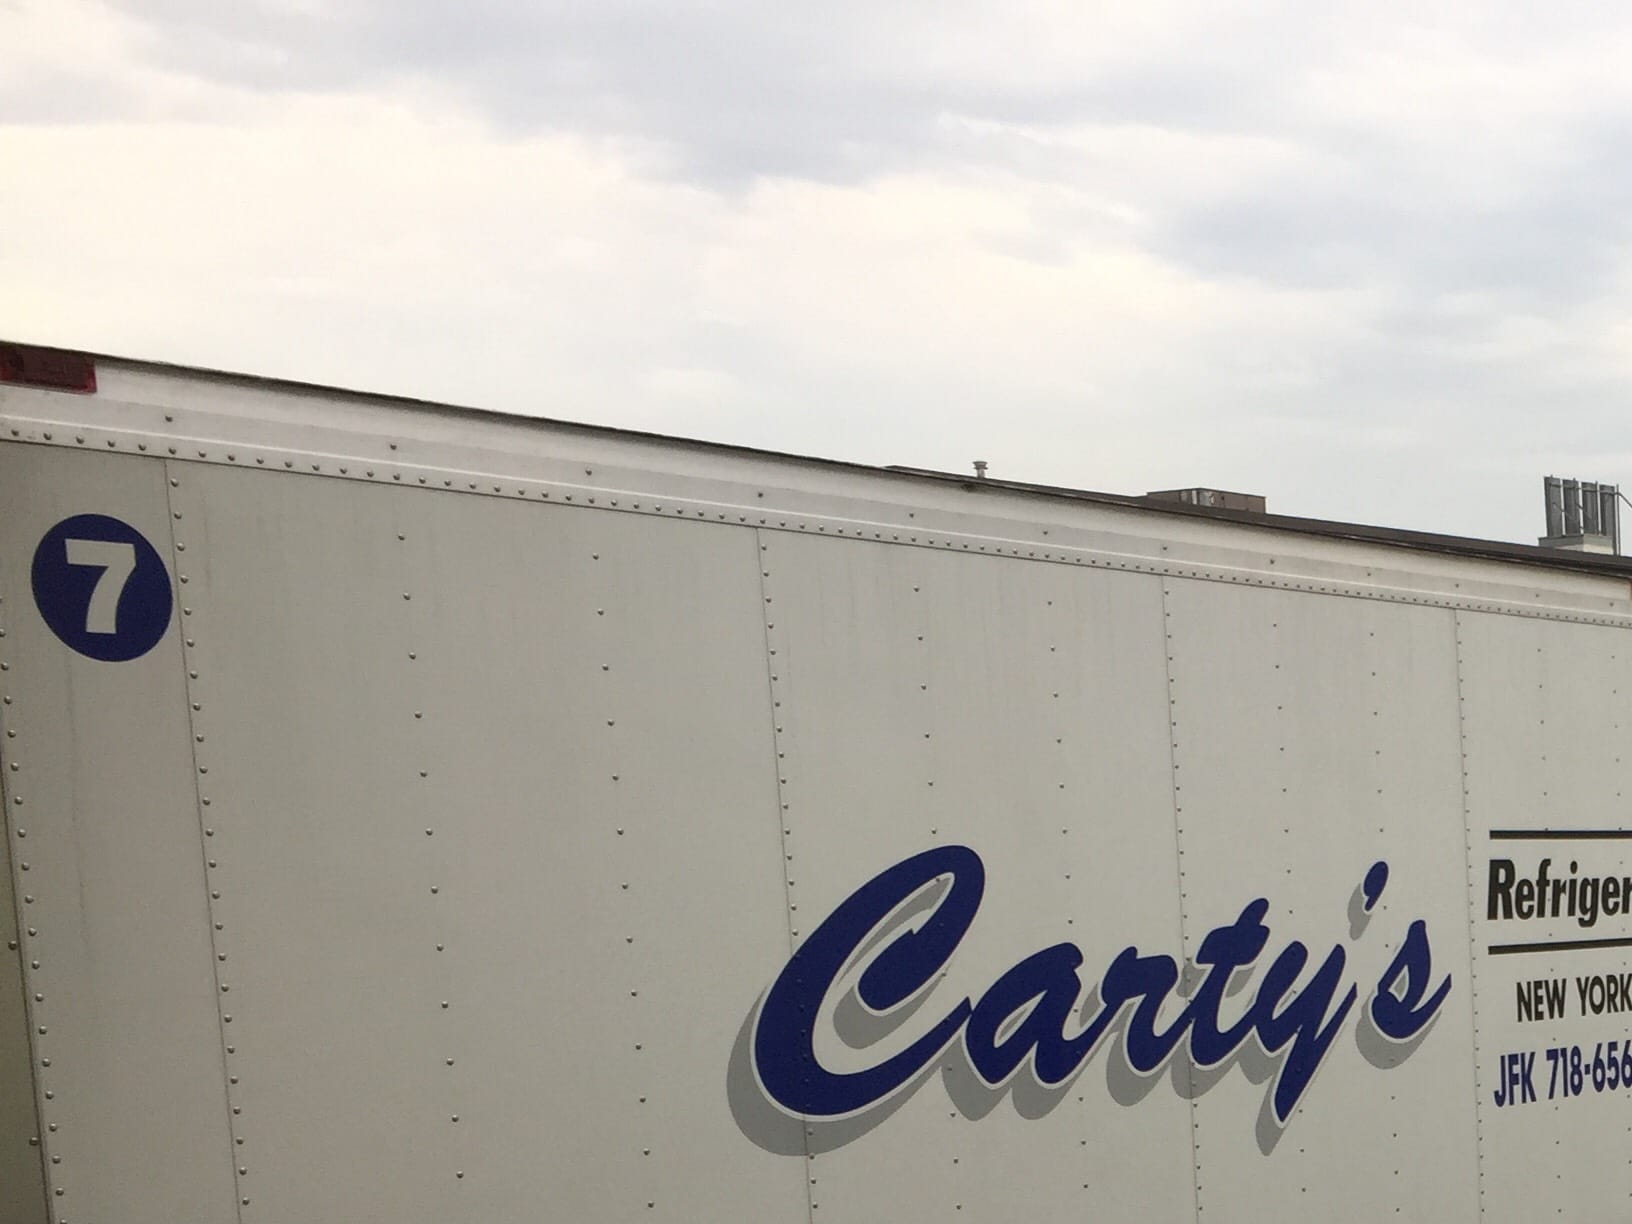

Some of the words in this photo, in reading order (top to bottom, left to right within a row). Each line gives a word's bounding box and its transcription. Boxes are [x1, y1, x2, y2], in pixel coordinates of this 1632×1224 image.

[65, 538, 137, 635] 7
[752, 844, 1453, 1127] Carty's
[1515, 978, 1567, 1023] NEW
[1493, 1051, 1537, 1108] JFK
